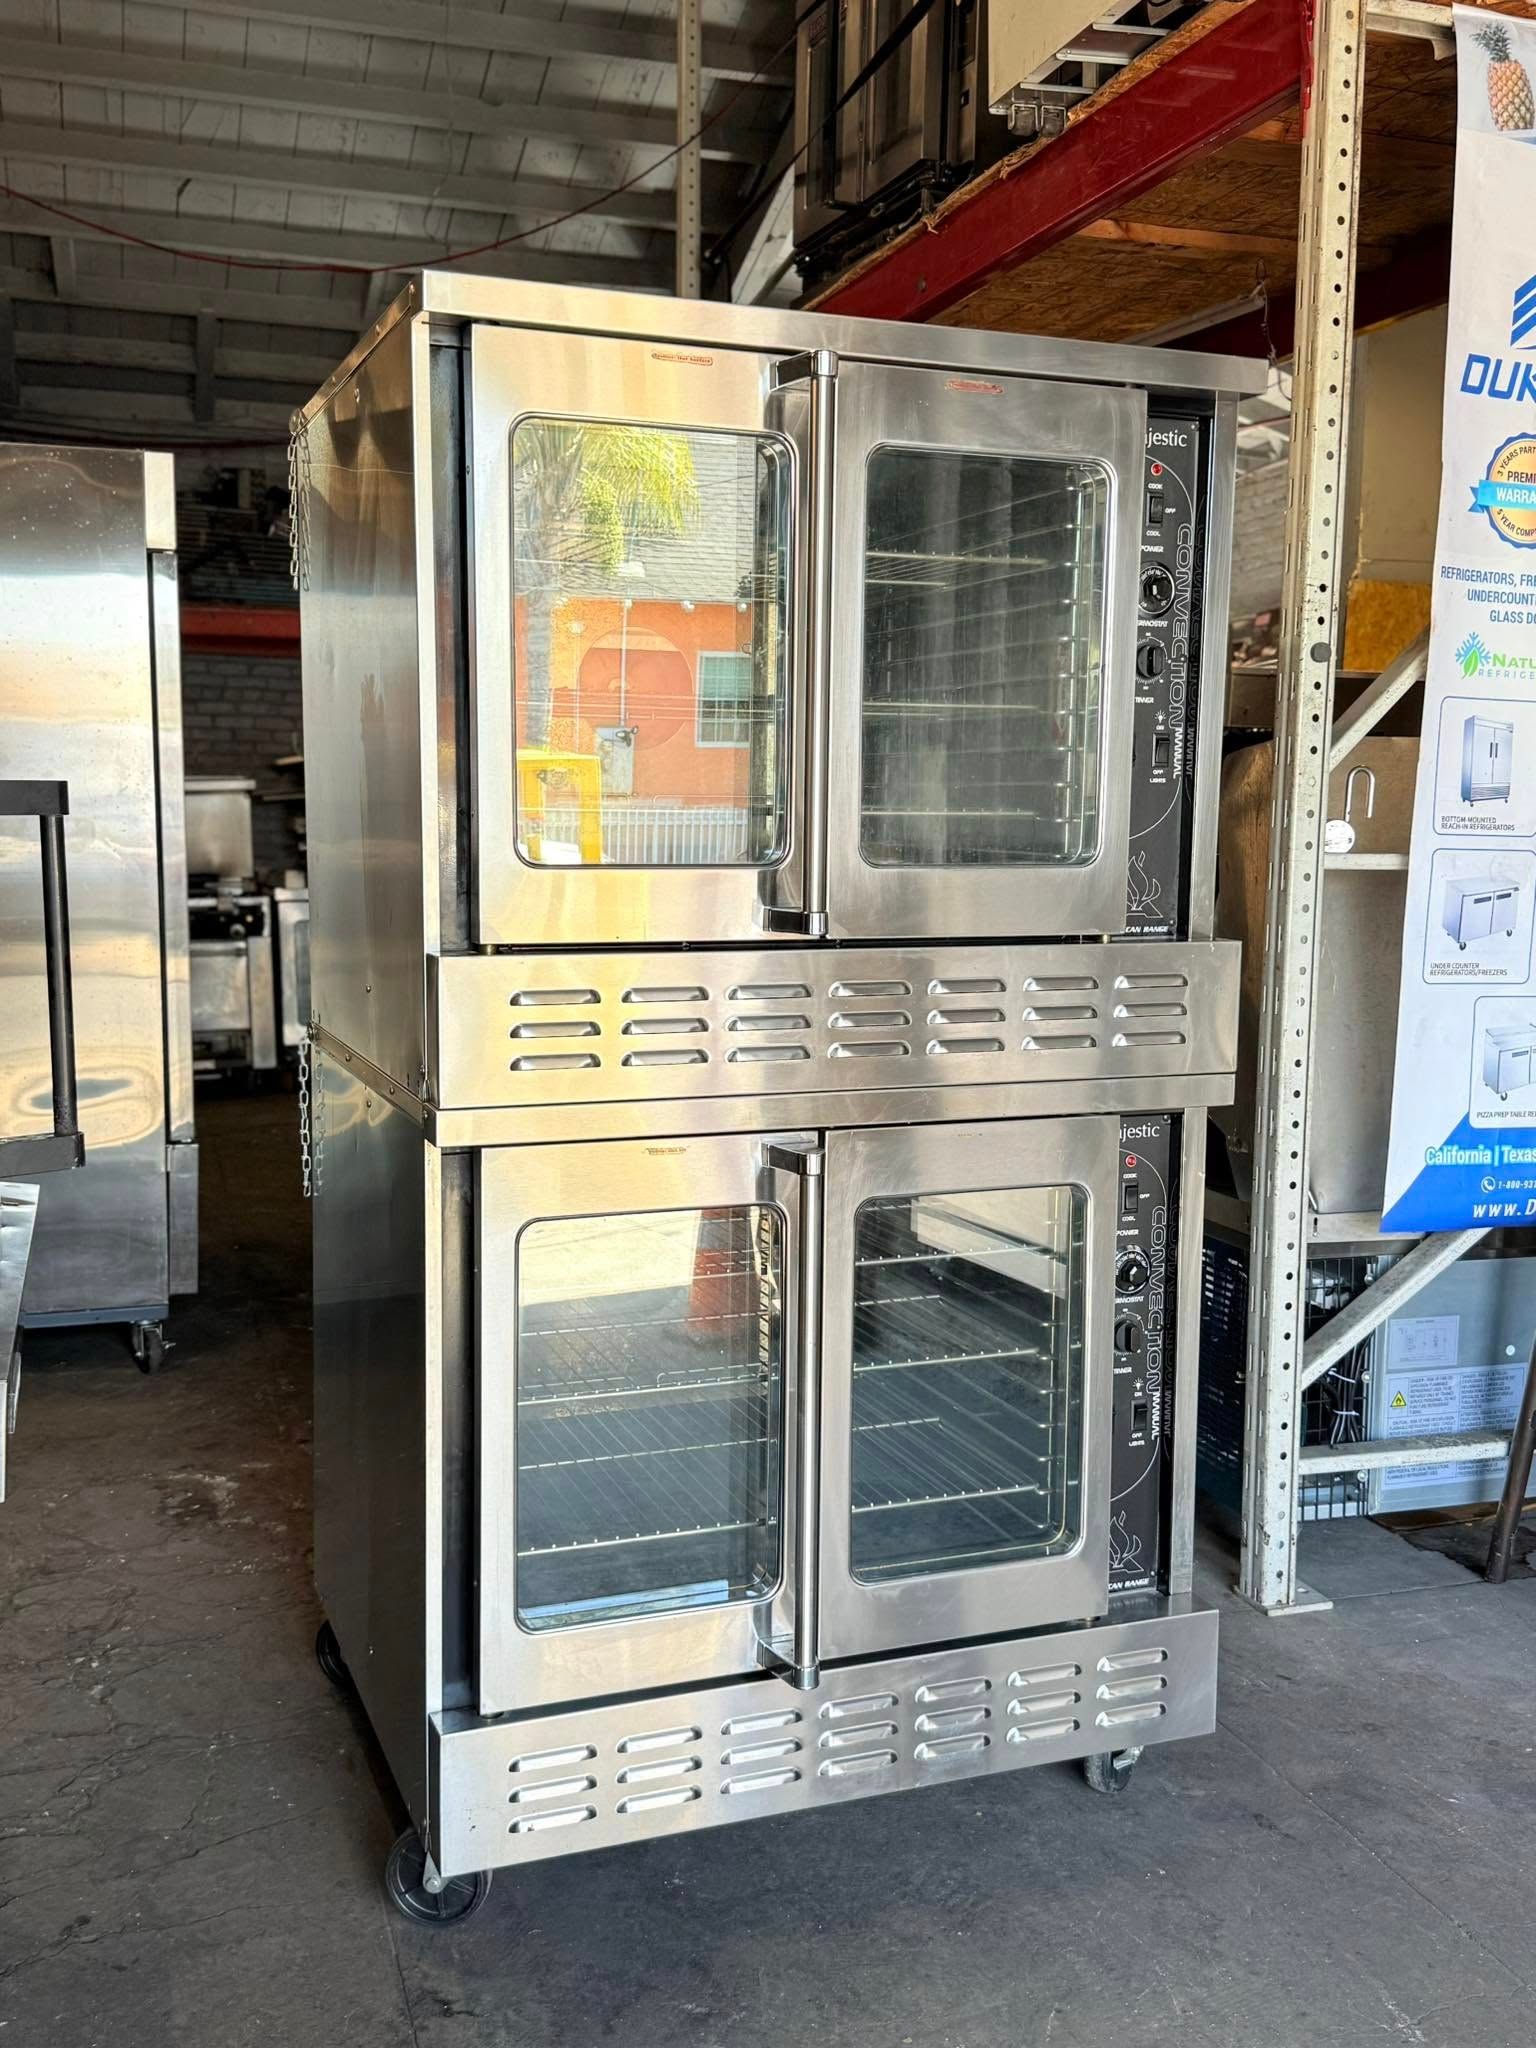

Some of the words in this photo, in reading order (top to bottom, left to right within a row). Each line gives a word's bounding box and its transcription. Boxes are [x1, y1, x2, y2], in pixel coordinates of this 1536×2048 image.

[1500, 449, 1519, 469] YEARS
[1496, 487, 1536, 504] WARRA
[1500, 514, 1516, 533] YEAR
[1440, 565, 1517, 587] REFRIGERATORS,
[1168, 523, 1193, 729] CONVECTION
[1490, 609, 1524, 624] GLASS
[1173, 727, 1183, 780] MANUAL
[1476, 1111, 1494, 1119] PIZZA
[1425, 1145, 1492, 1166] California
[1501, 1145, 1536, 1165] Texas
[1146, 1205, 1167, 1394] CONVECTION
[1151, 1392, 1161, 1441] MANUAL
